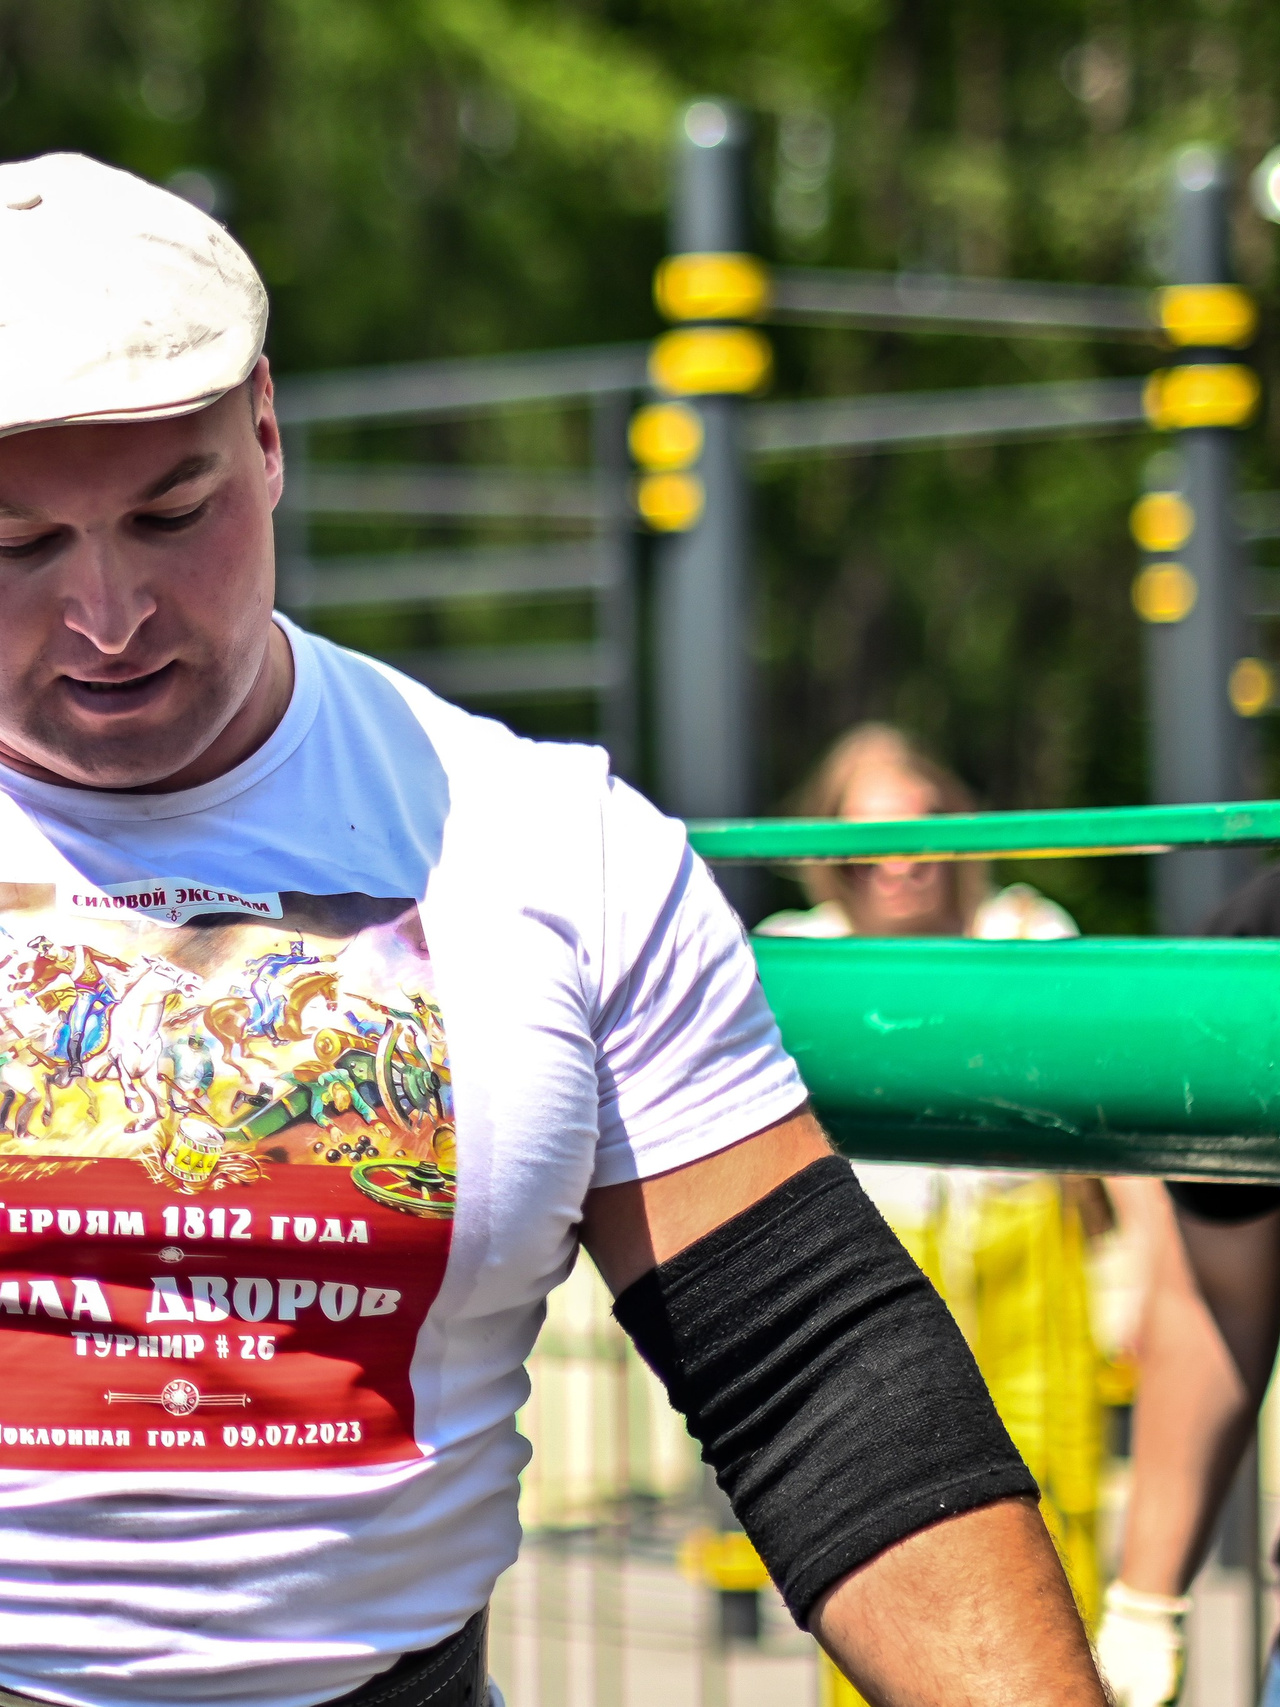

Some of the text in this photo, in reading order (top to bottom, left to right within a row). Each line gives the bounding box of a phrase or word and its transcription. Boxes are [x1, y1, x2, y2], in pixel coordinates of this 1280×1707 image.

[72, 887, 271, 913] СИЛОВОЙ ЭКСТРИМ
[161, 1205, 254, 1241] 1812
[145, 1276, 402, 1324] ДВОРОВ
[70, 1330, 276, 1361] ТУРНИР # 26
[222, 1420, 363, 1448] 09.07.2023
